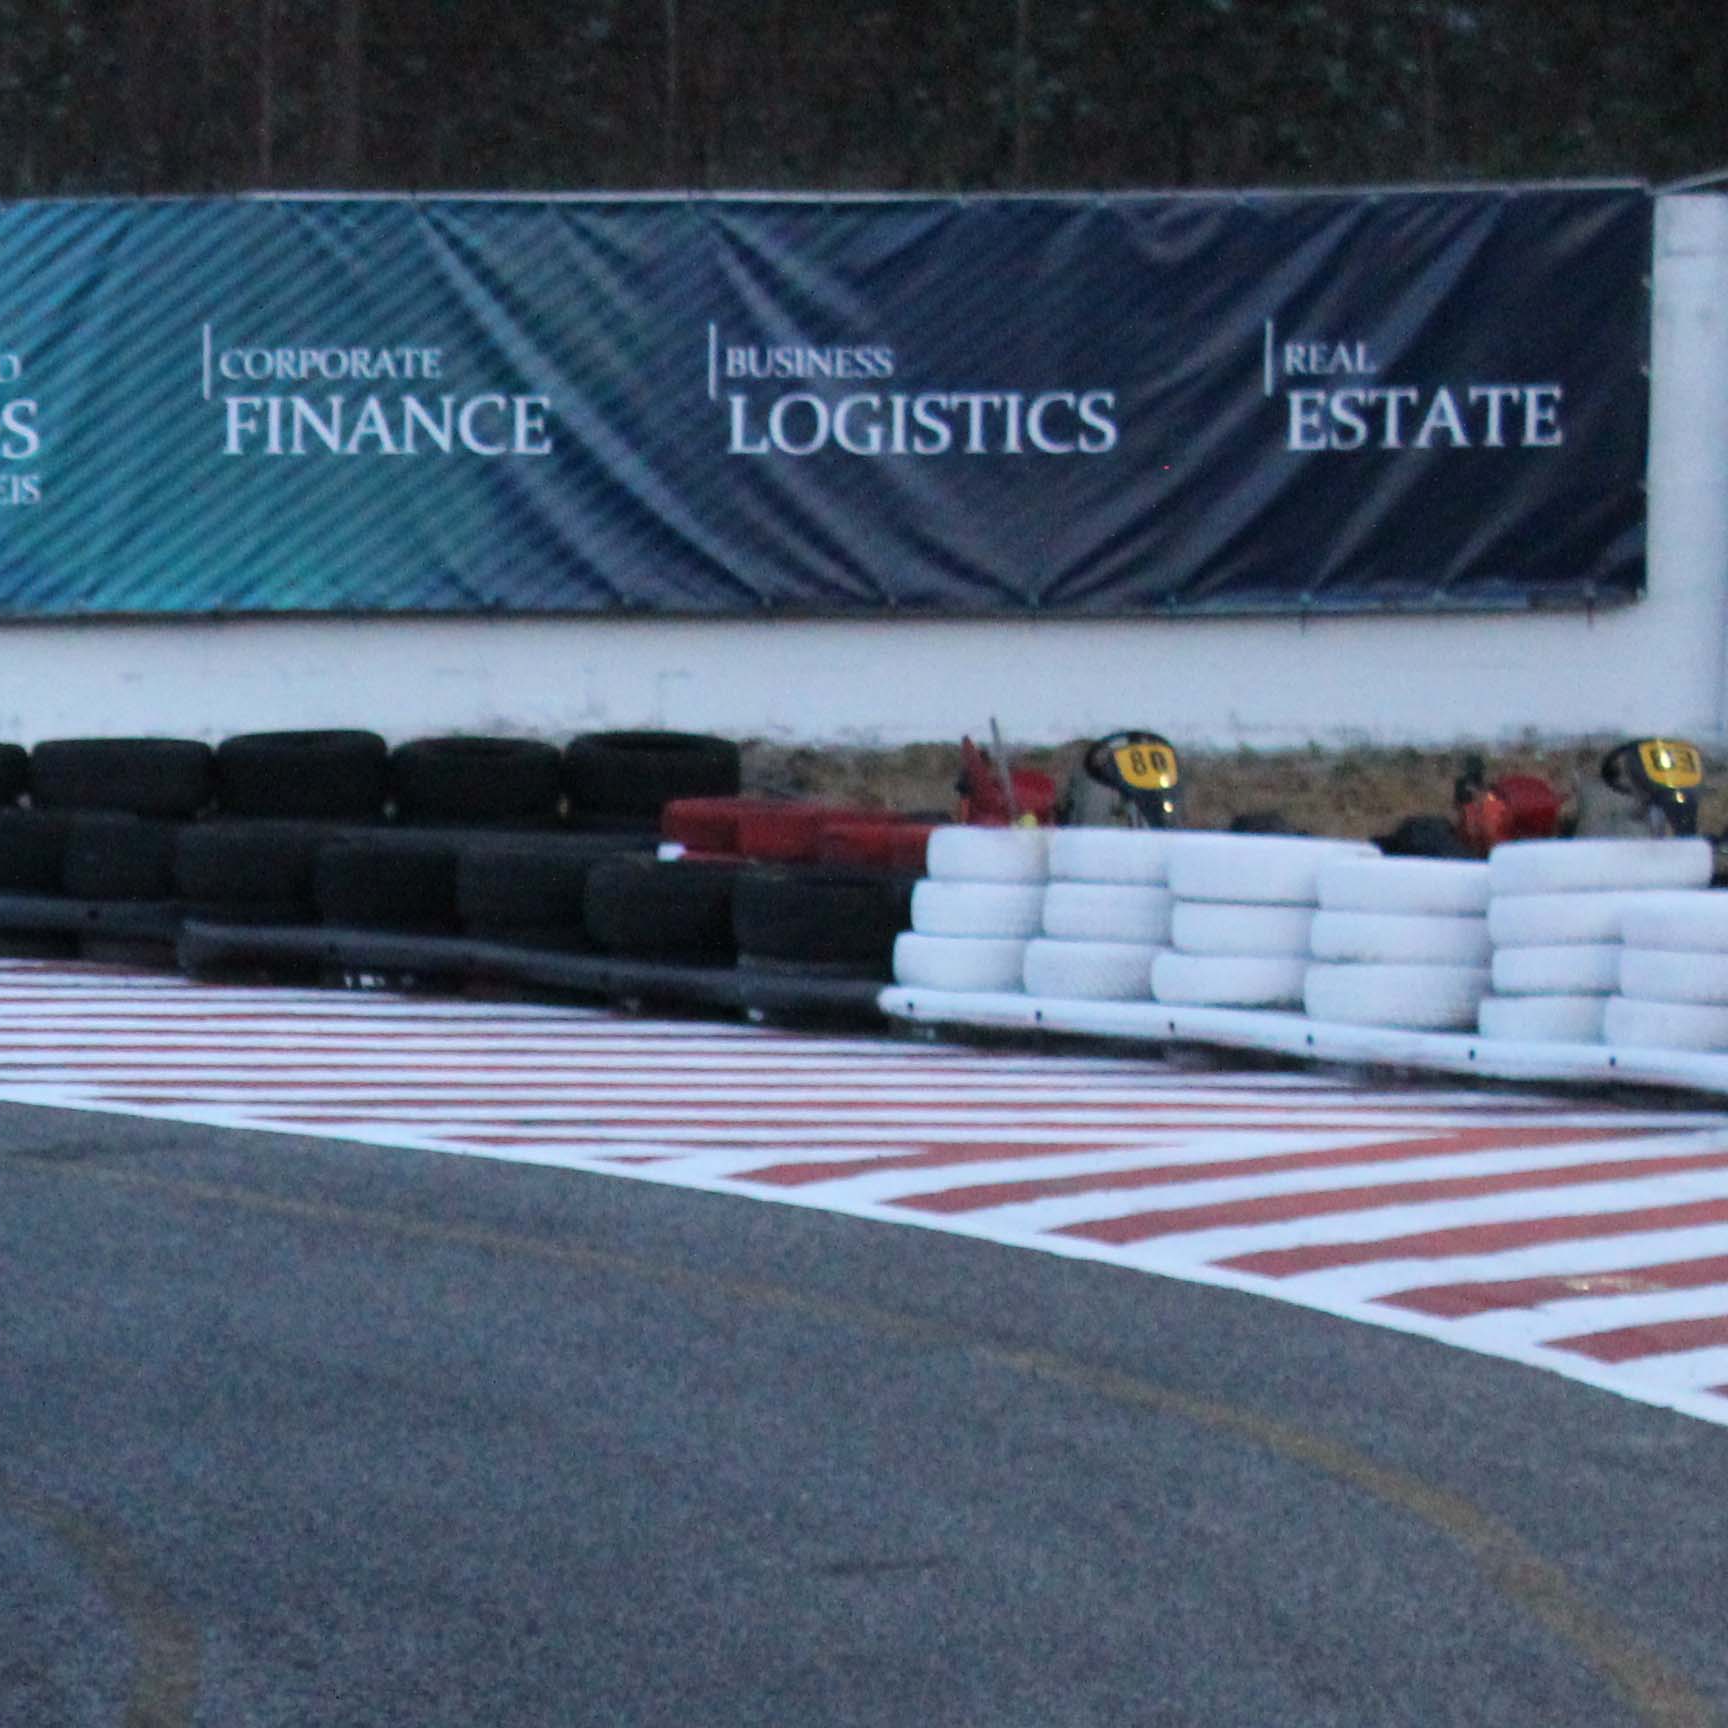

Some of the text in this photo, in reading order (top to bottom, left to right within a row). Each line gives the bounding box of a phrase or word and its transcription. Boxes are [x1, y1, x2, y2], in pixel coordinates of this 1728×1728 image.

[219, 347, 442, 381] CORPORATE
[725, 346, 894, 379] BUSINESS
[1285, 343, 1375, 376] REAL
[222, 395, 553, 456] FINANCE
[727, 391, 1118, 457] LOGISTICS
[1286, 382, 1564, 454] ESTATE
